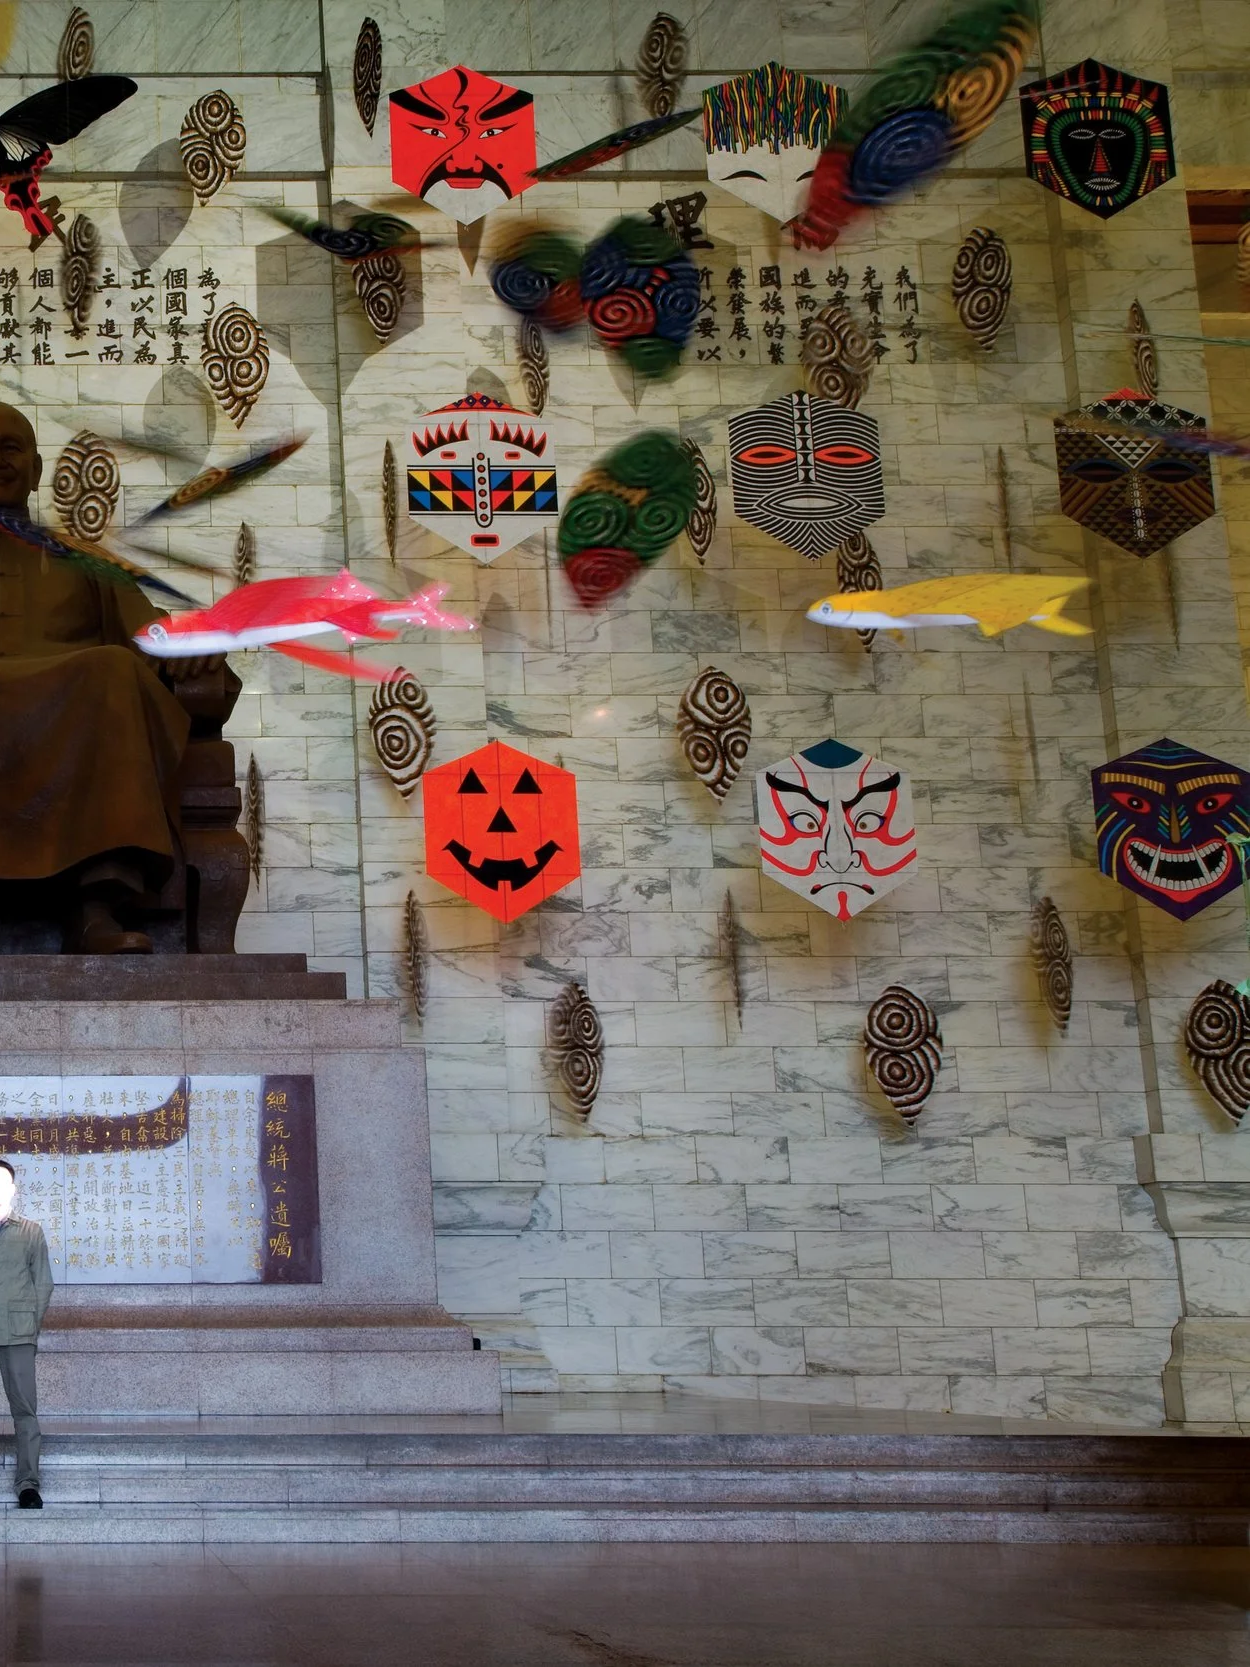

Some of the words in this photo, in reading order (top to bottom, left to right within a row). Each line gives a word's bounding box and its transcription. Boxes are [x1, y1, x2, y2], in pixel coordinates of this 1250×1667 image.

[28, 267, 56, 365] 個人都能
[130, 268, 157, 365] 正以民為
[162, 267, 190, 365] 個國家真
[758, 264, 786, 365] 國族的繁
[860, 266, 891, 364] 充實生命
[893, 265, 921, 364] 我們為了
[28, 1091, 48, 1226] 全黨同志，絕不
[265, 1090, 292, 1260] 總統蔣公遺囑
